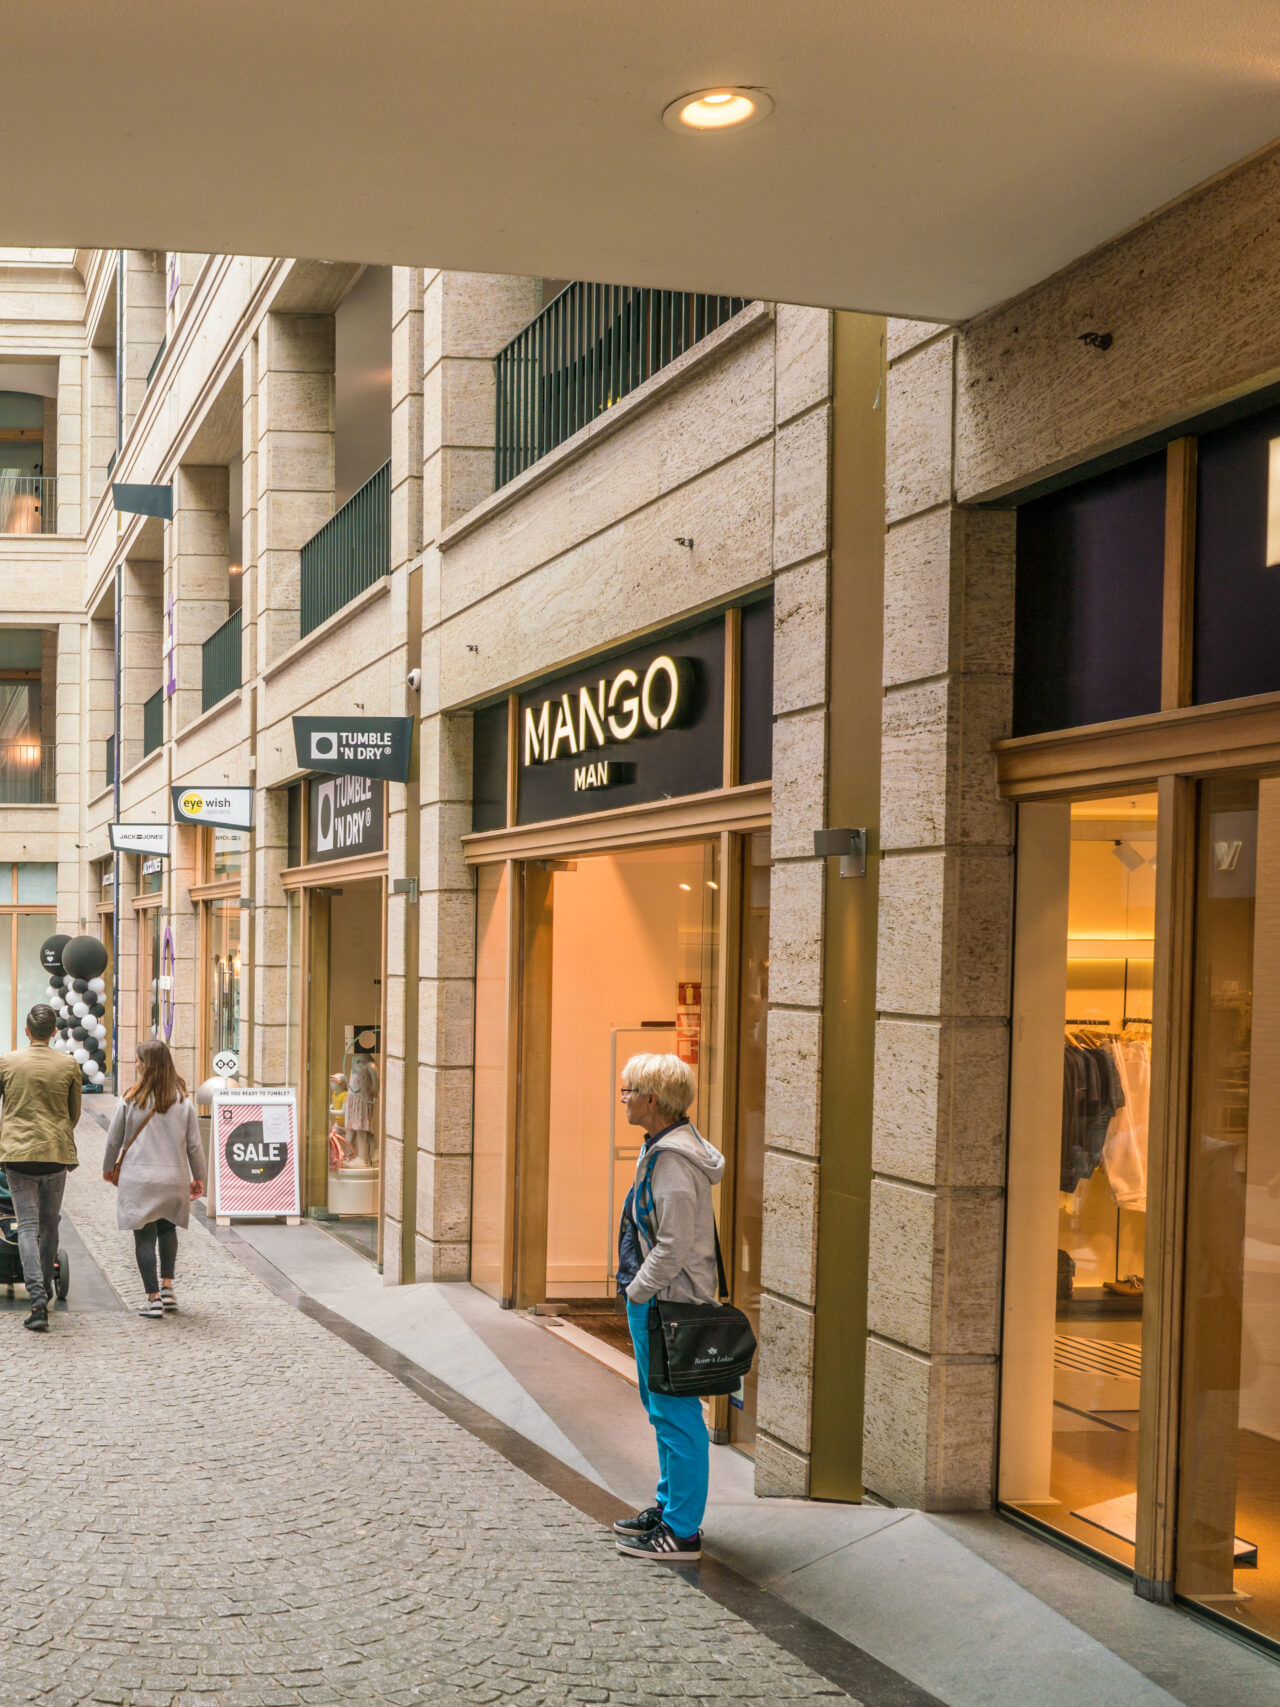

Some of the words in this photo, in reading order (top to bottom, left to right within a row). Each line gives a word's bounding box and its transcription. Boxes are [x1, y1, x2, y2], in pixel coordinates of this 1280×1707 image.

[524, 655, 679, 767] MANGO
[339, 732, 392, 745] TUMBLE
[574, 760, 609, 792] MAN
[183, 800, 203, 811] eye
[205, 797, 231, 808] wish
[232, 1143, 281, 1162] SALE
